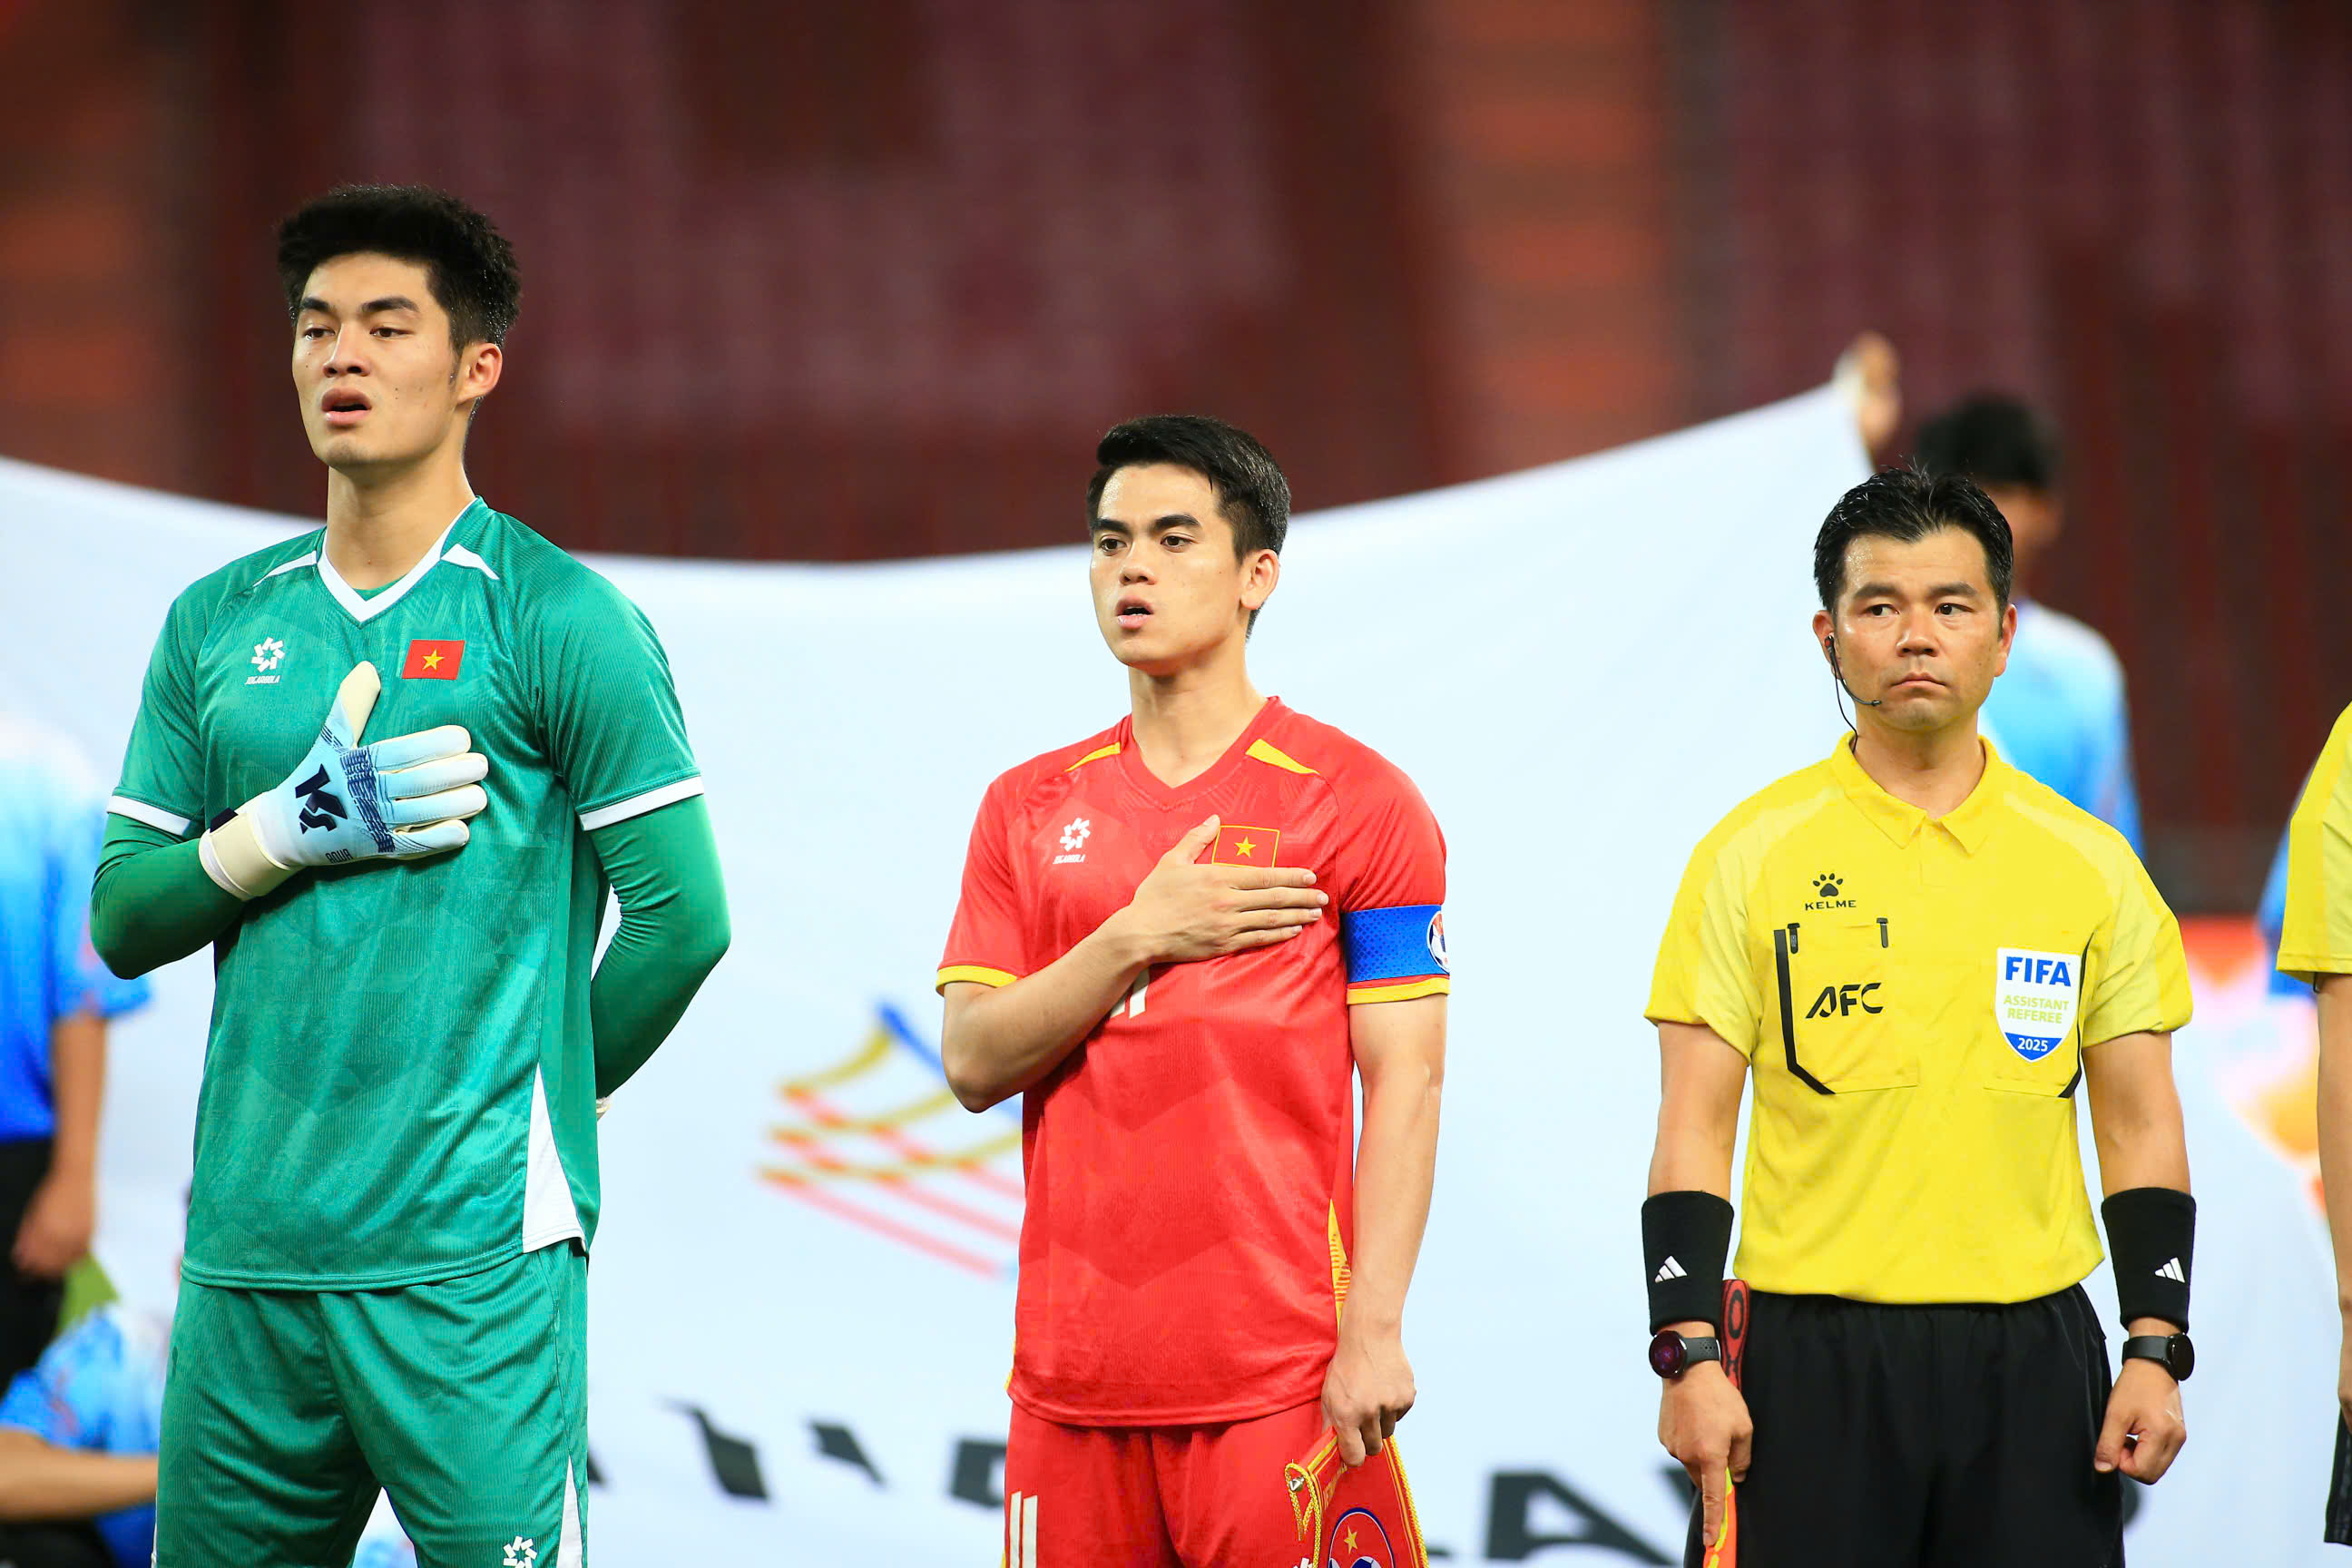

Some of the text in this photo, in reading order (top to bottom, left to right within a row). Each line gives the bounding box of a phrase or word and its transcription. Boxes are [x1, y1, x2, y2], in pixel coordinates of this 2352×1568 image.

[1805, 899, 1857, 911] KELME
[2005, 956, 2072, 987] FIFA
[1805, 982, 1884, 1019] AFC
[2003, 994, 2070, 1011] ASSISTANT
[2007, 1007, 2063, 1024] REFEREE
[2017, 1037, 2049, 1053] 2025
